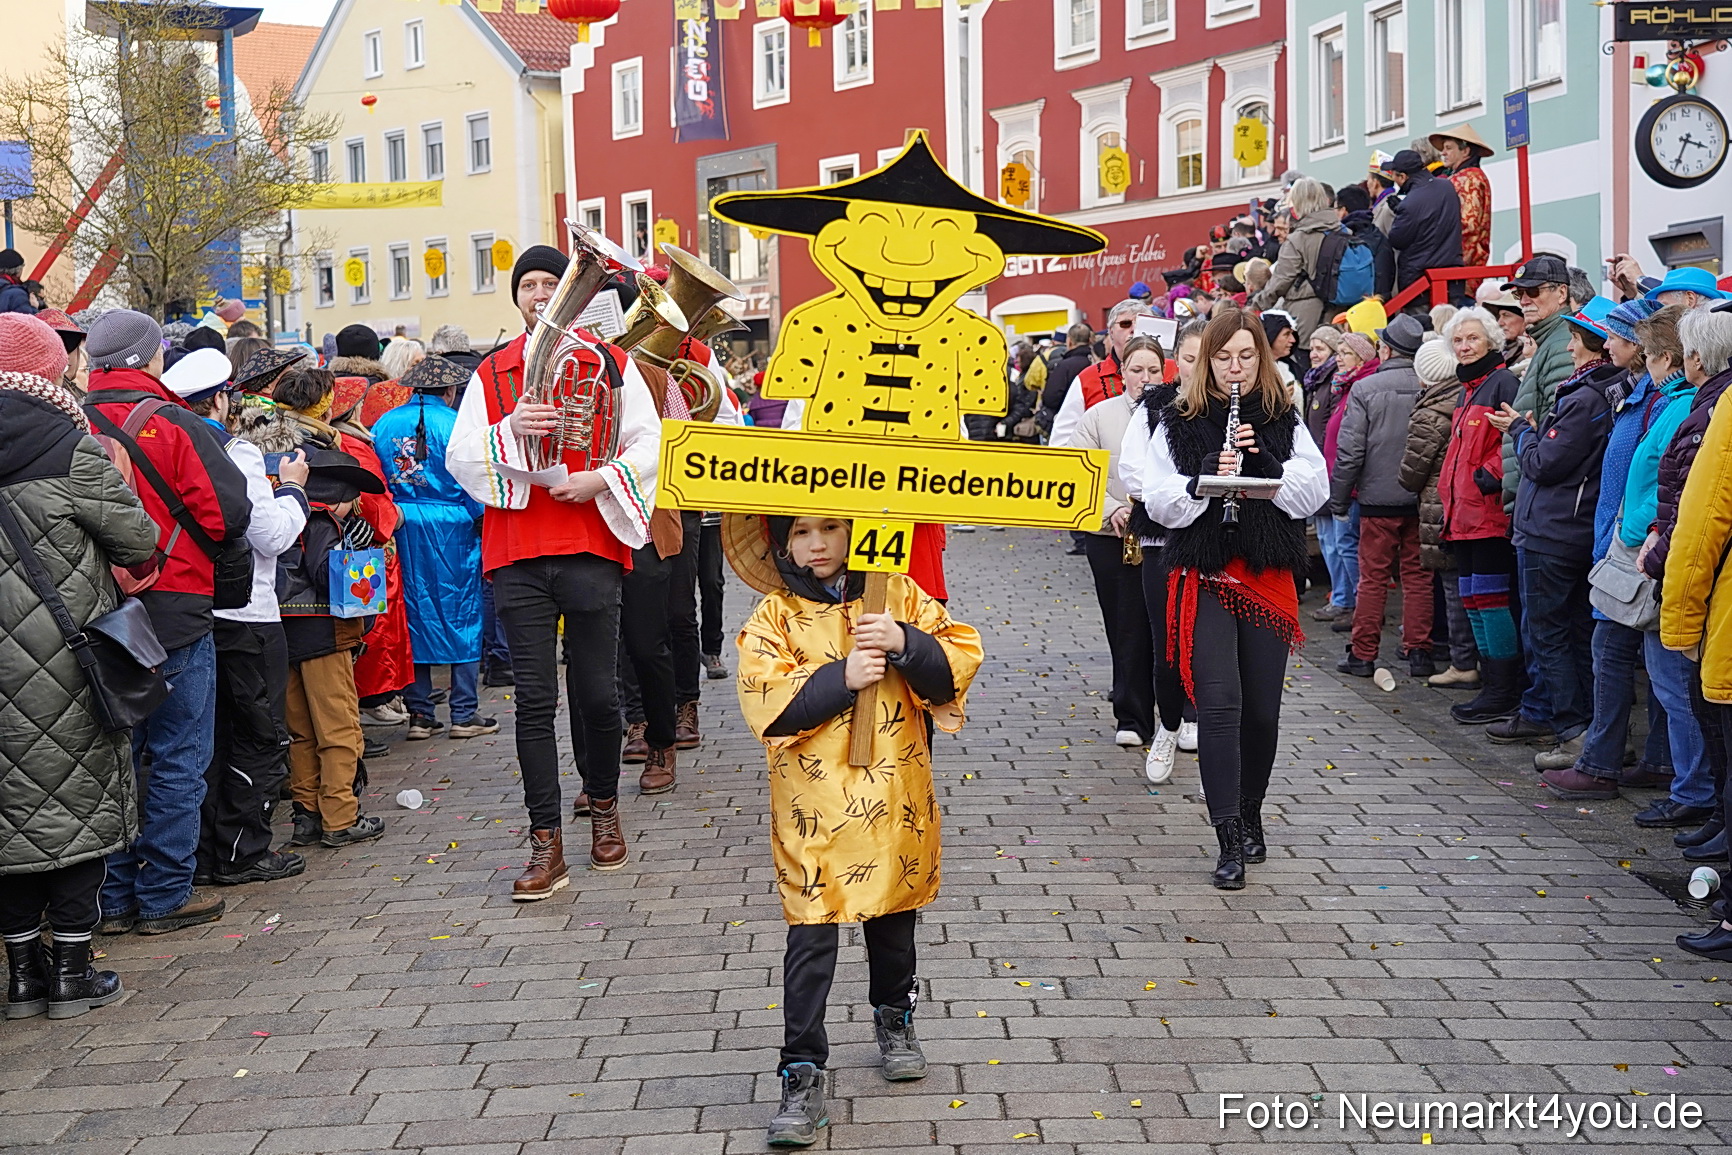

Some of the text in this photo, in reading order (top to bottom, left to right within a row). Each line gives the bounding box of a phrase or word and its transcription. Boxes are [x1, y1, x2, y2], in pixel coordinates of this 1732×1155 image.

[684, 451, 1077, 509] Stadtkapelle Riedenburg
[854, 528, 907, 566] 44
